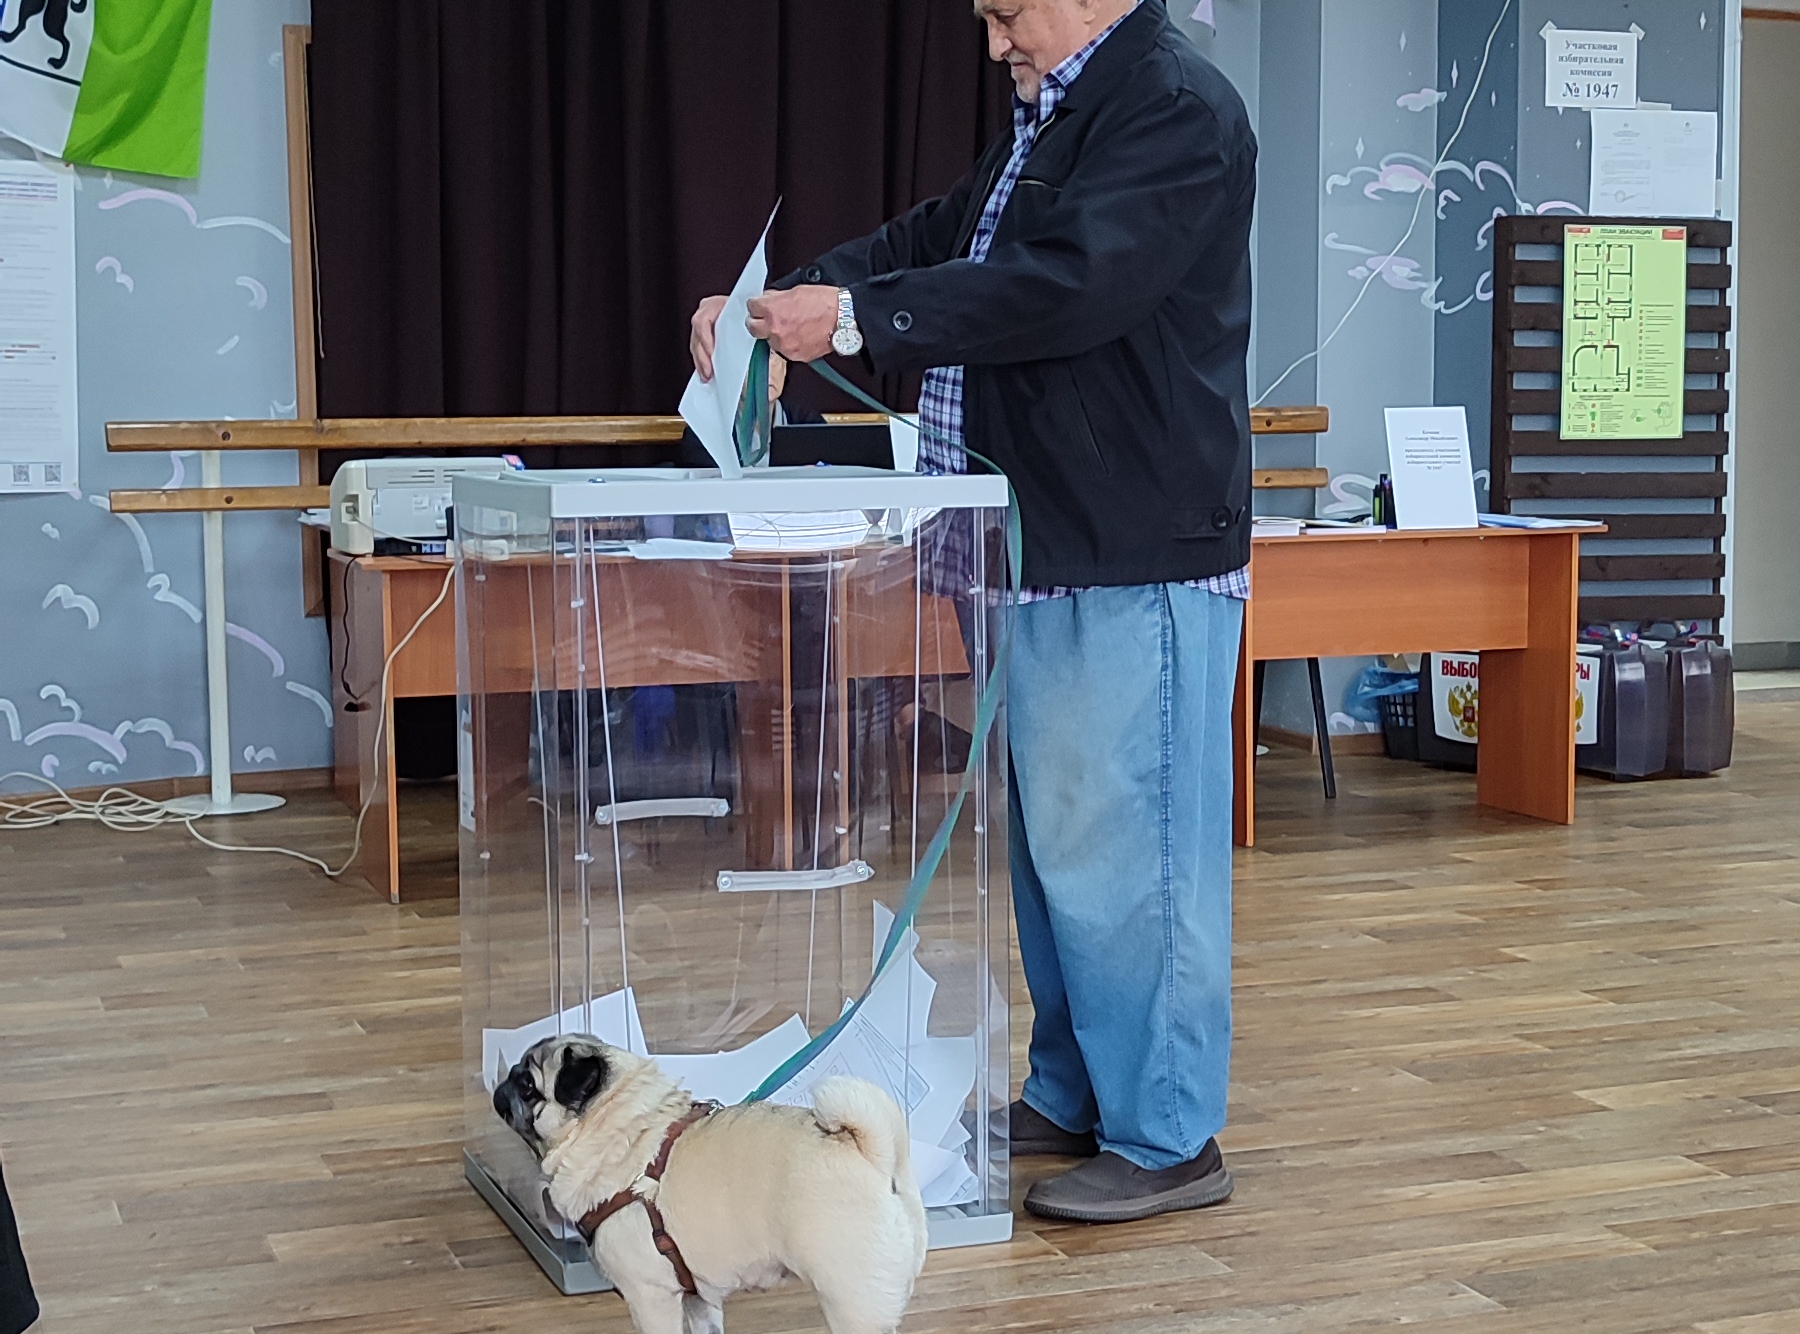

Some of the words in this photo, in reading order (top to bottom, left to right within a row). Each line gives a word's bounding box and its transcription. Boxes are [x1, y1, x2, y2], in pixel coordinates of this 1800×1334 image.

[1565, 40, 1618, 51] Участковая
[1558, 53, 1624, 65] избирательная
[1569, 69, 1613, 77] комиссия
[1562, 82, 1580, 98] №
[1585, 82, 1619, 99] 1947
[1441, 659, 1478, 678] ВЫБО
[1575, 662, 1590, 681] РЫ
